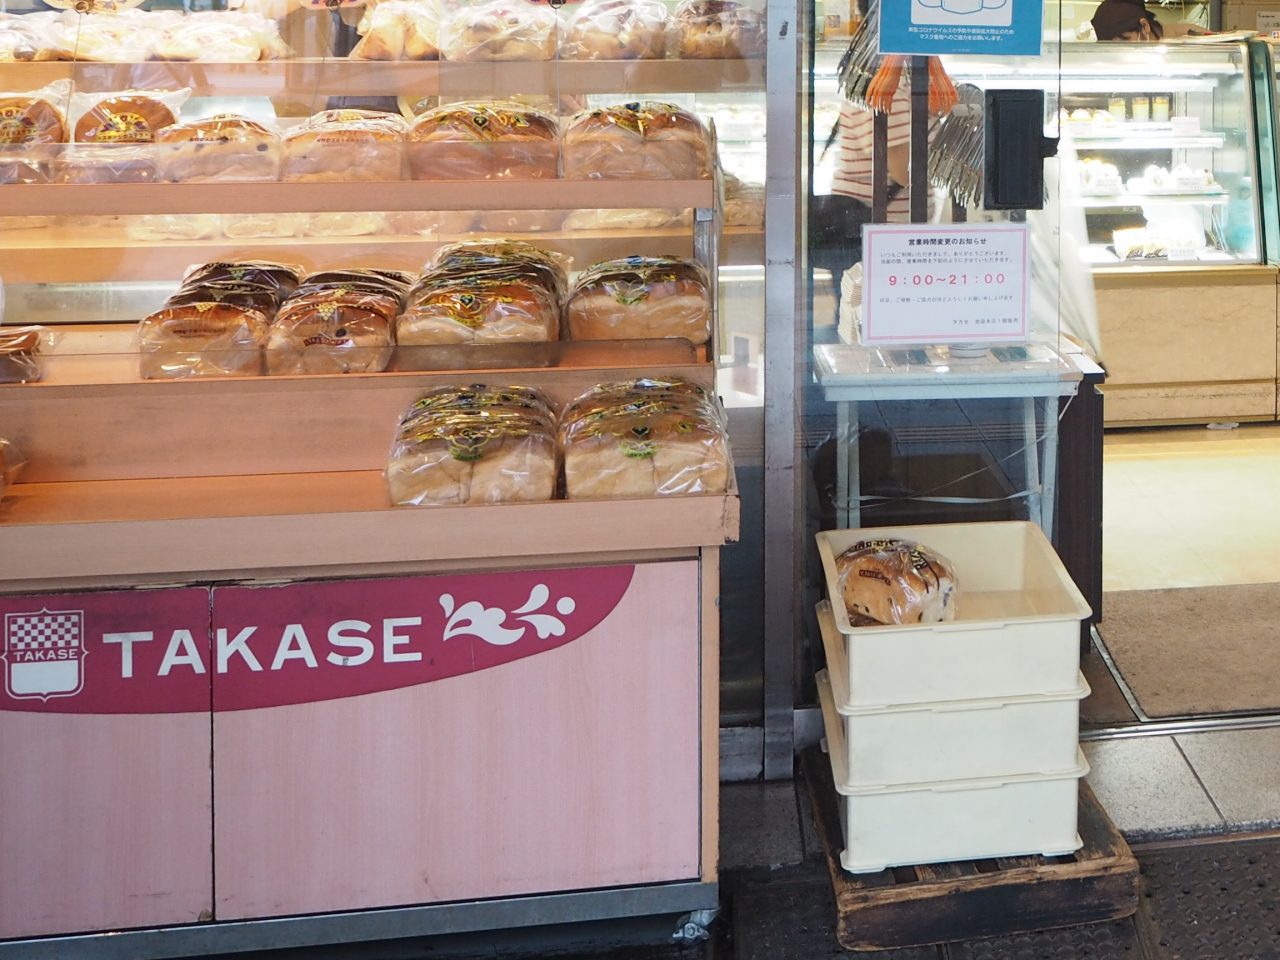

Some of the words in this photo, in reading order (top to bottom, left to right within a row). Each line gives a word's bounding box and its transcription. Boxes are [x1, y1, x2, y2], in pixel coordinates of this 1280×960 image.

[908, 237, 988, 247] 営業時間変更のお知らせ
[102, 616, 423, 679] TAKASE
[13, 648, 79, 662] TAKASE
